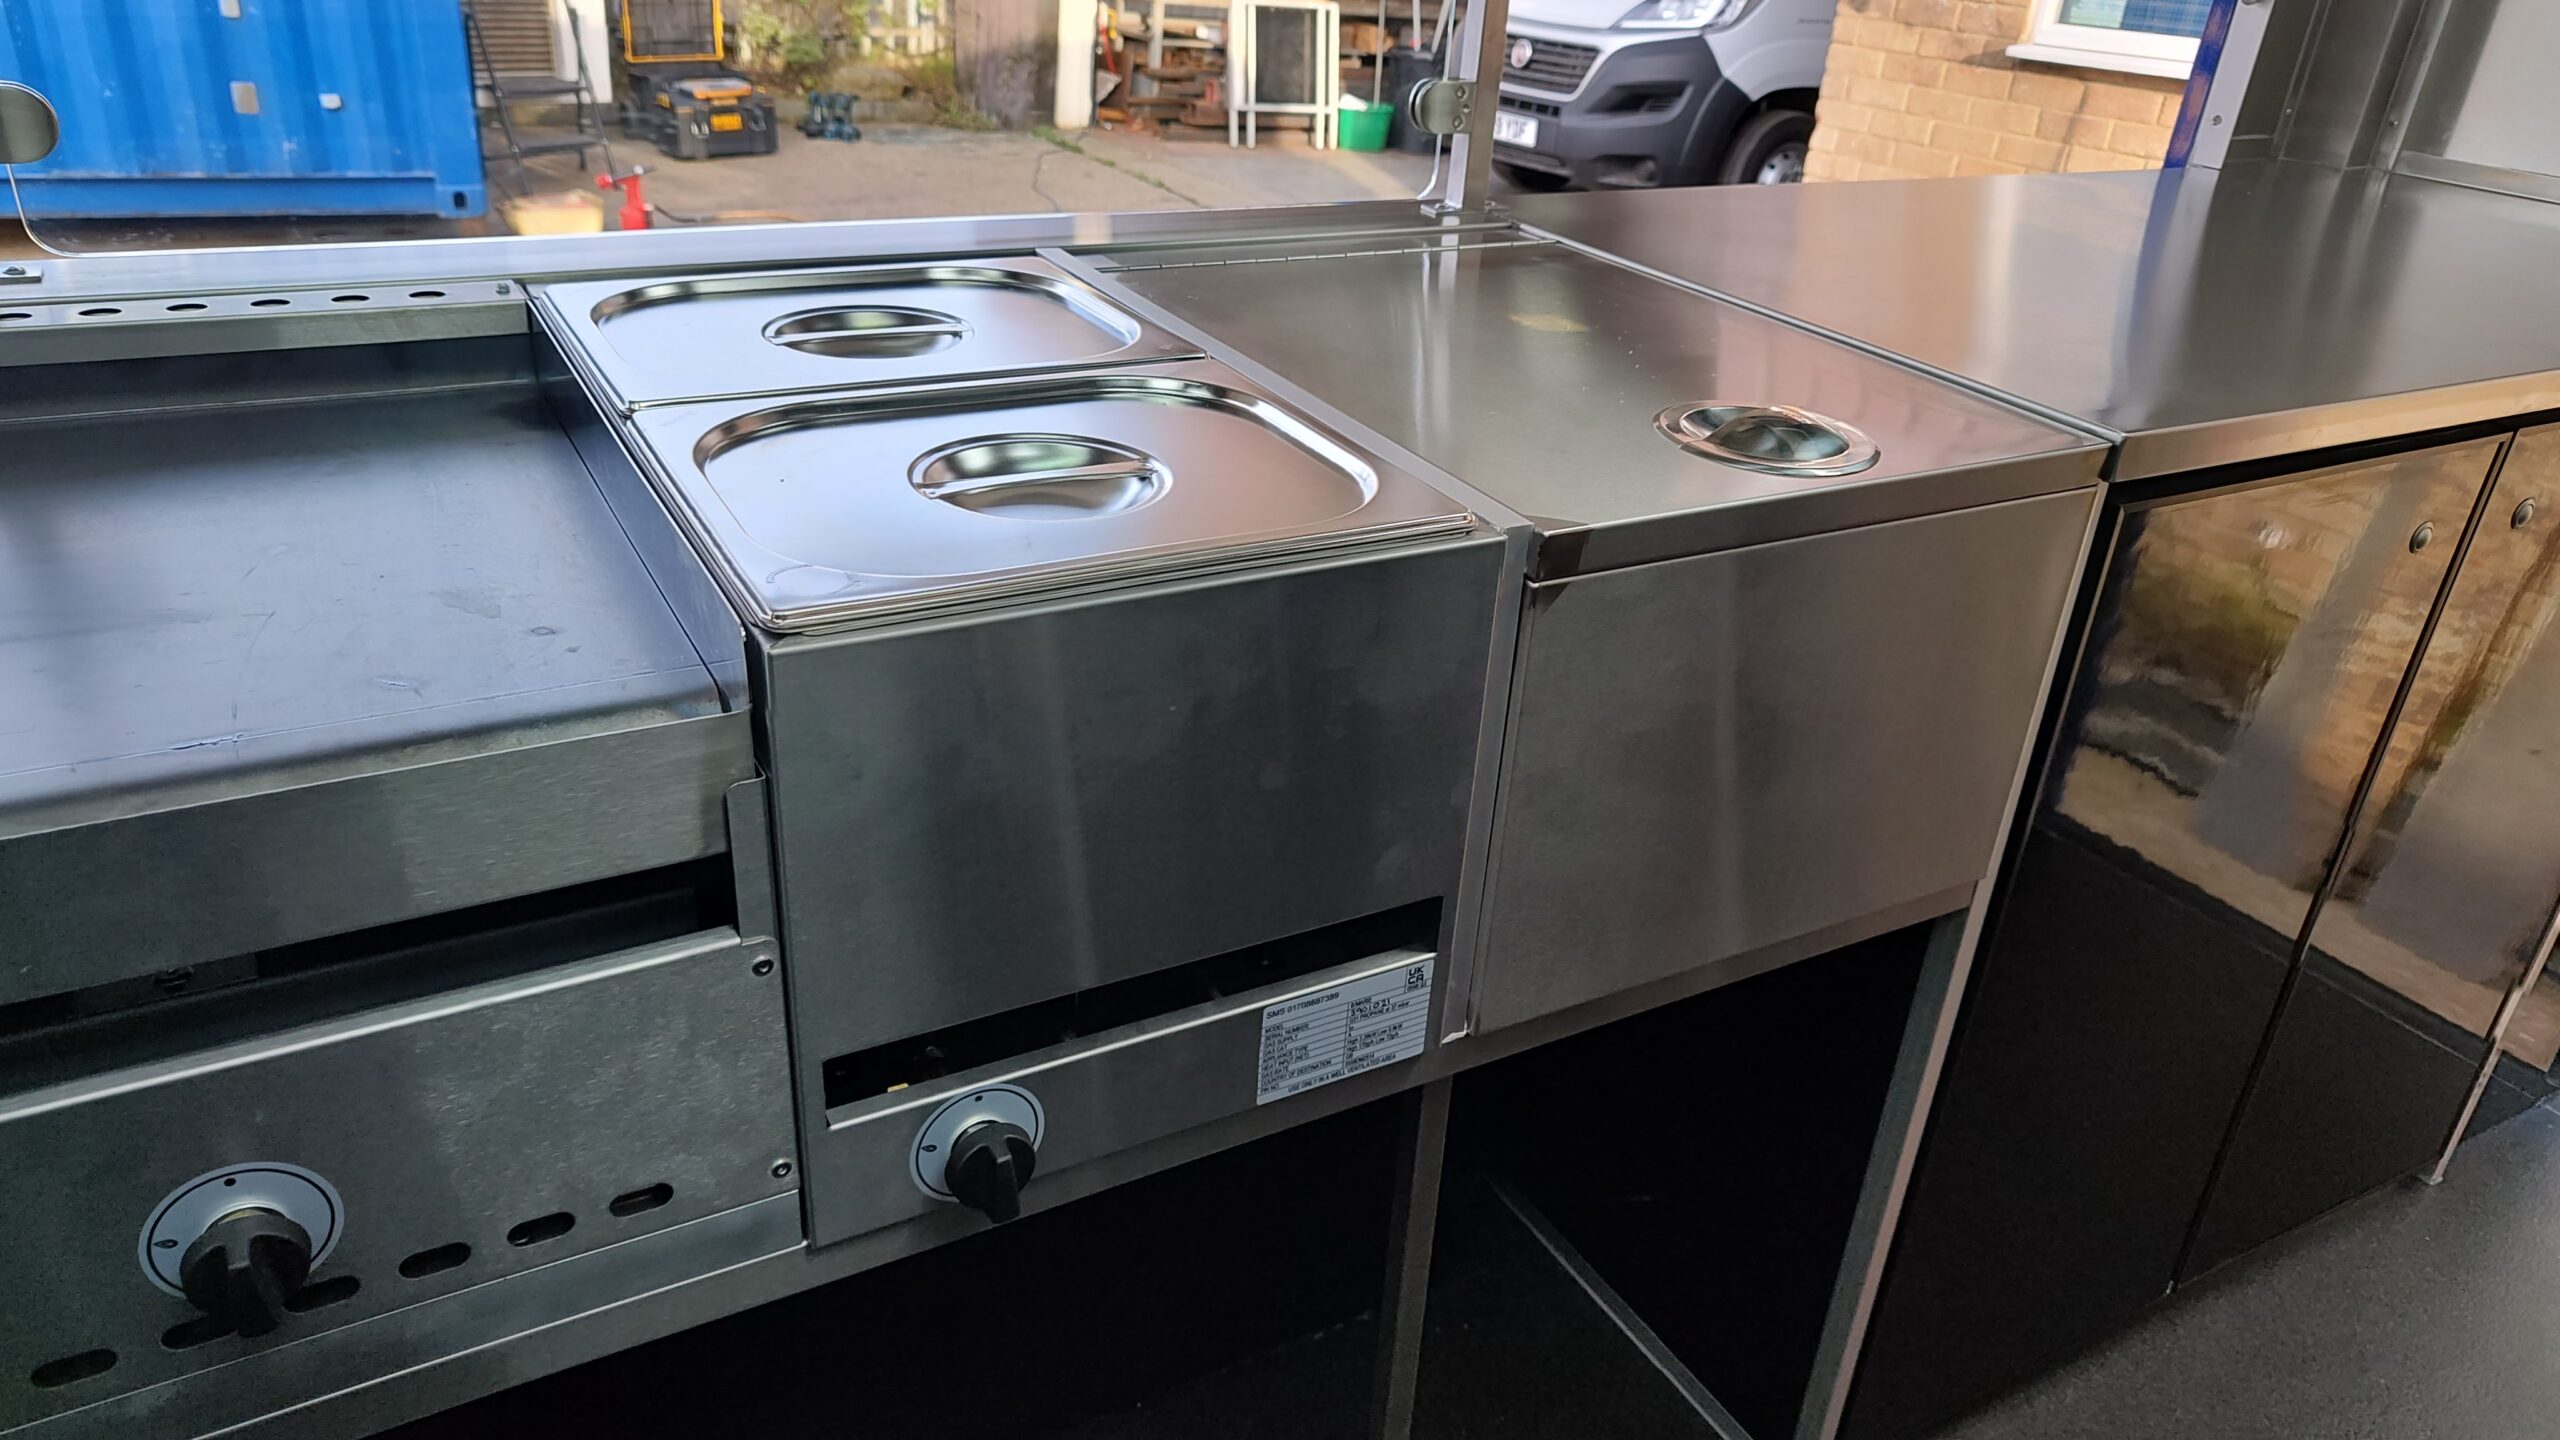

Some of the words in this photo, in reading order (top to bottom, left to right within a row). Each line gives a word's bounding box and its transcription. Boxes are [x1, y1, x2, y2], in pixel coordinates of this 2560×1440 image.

[1267, 1008, 1285, 1019] SMS
[1361, 1007, 1384, 1019] PROPANE
[1286, 1023, 1309, 1034] NUMBER
[1278, 1034, 1298, 1044] SUPPLY
[1295, 1045, 1308, 1053] TYPE
[1347, 1058, 1380, 1074] VENTILATED
[1381, 1053, 1396, 1062] AREA
